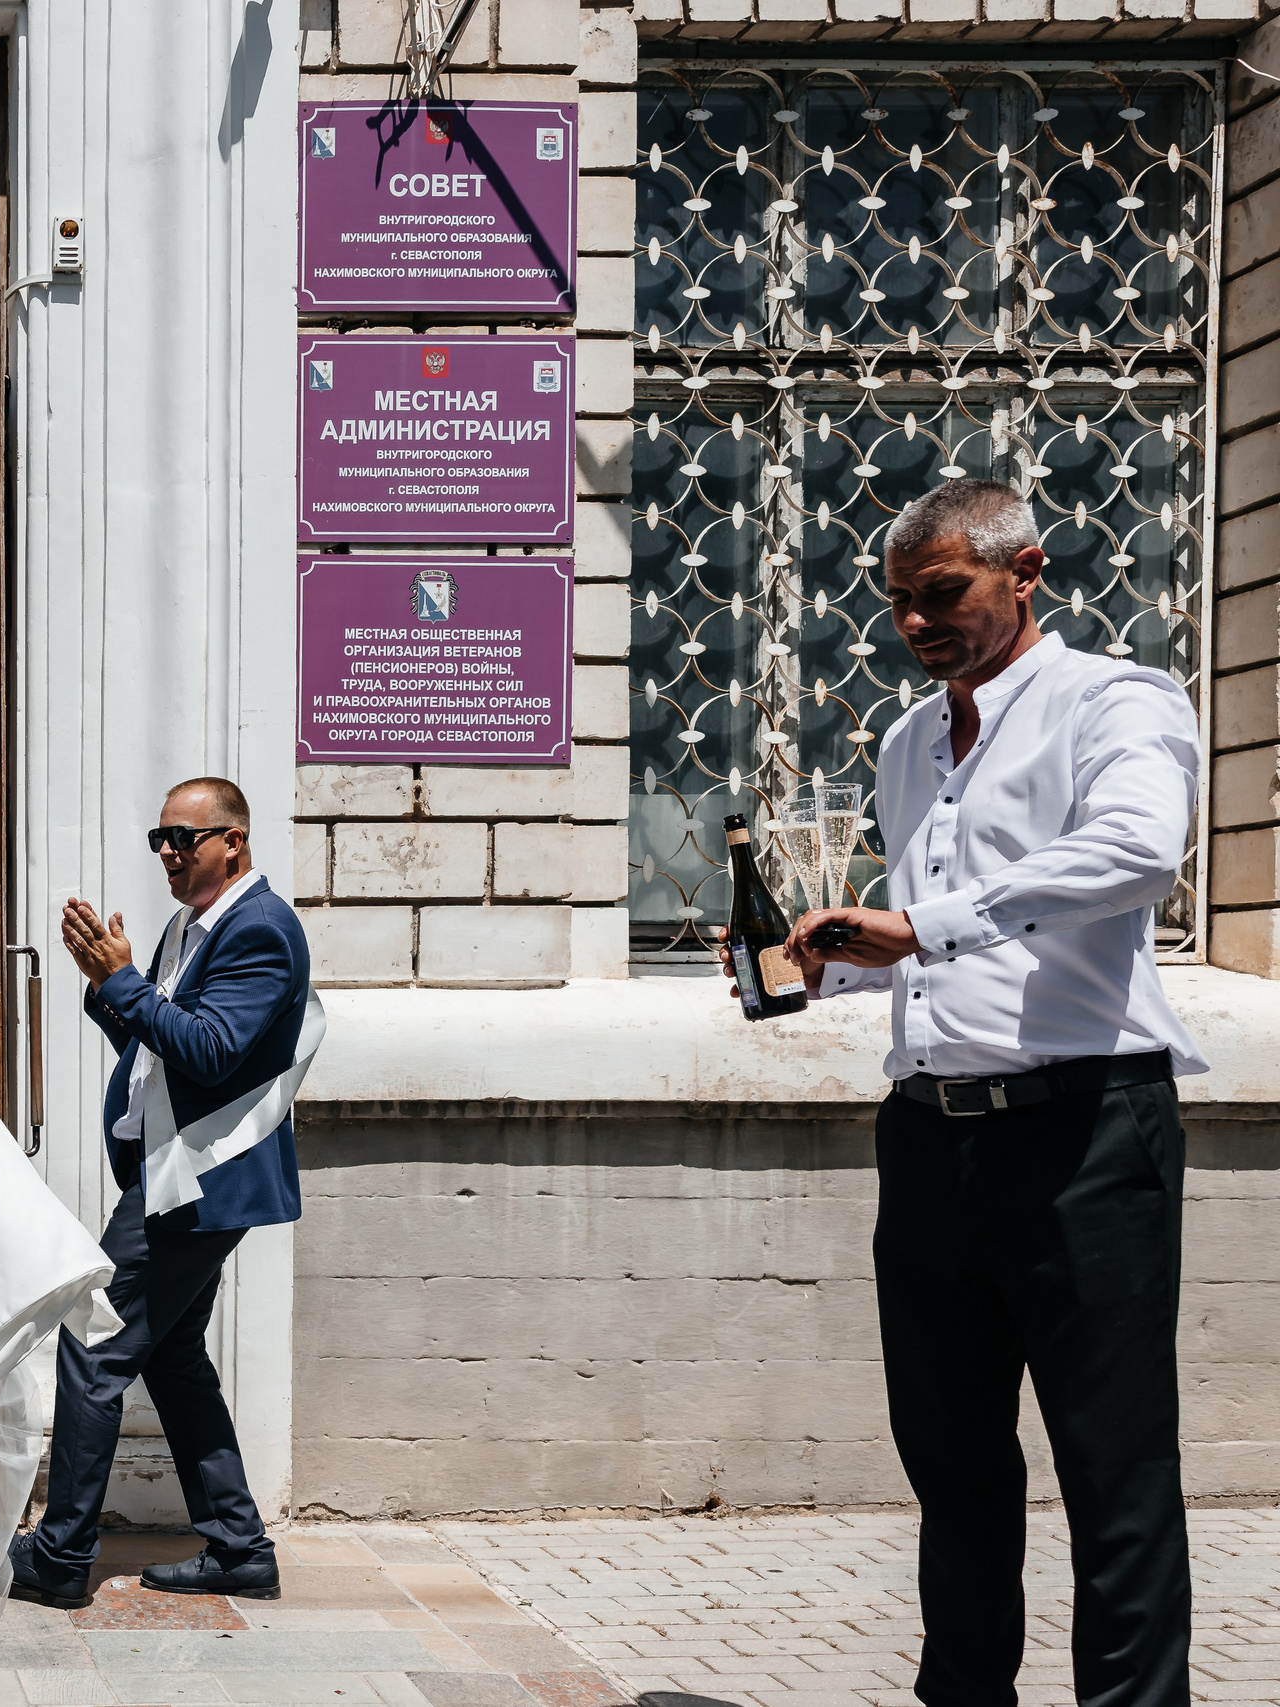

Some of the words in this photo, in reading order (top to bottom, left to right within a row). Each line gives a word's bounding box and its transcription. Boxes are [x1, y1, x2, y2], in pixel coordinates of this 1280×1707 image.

[389, 174, 487, 197] СОВЕТ
[379, 215, 496, 226] ВНУТРИГОРОДСКОГО
[341, 232, 448, 244] МУНИЦИПАЛЬНОГО
[450, 233, 532, 243] ОБРАЗОВАНИЯ
[391, 252, 398, 260] г.
[400, 250, 482, 260] СЕВАСТОПОЛЯ
[314, 267, 406, 278] НАХИМОВСКОГО
[407, 268, 515, 279] МУНИЦИПАЛЬНОГО
[516, 268, 558, 279] ОКРУГА
[374, 390, 497, 411] МЕСТНАЯ
[320, 419, 551, 444] АДМИНИСТРАЦИЯ
[376, 450, 493, 461] ВНУТРИГОРОДСКОГО
[338, 467, 445, 479] МУНИЦИПАЛЬНОГО
[447, 467, 530, 478] ОБРАЗОВАНИЯ
[388, 487, 395, 495] г.
[398, 485, 480, 495] СЕВАСТОПОЛЯ
[312, 502, 403, 512] НАХИМОВСКОГО
[405, 502, 512, 514] МУНИЦИПАЛЬНОГО
[514, 503, 556, 513] ОКРУГА
[344, 628, 407, 640] МЕСТНАЯ
[410, 629, 522, 642] ОБЩЕСТВЕННАЯ
[343, 645, 440, 658] ОРГАНИЗАЦИЯ
[443, 646, 522, 657] ВЕТЕРАНОВ
[350, 662, 458, 676] (ПЕНСИОНЕРОВ)
[462, 661, 515, 677] ВОЙНЫ,
[341, 679, 386, 692] ТРУДА,
[389, 679, 492, 691] ВООРУЖЕННЫХ
[496, 680, 523, 692] СИЛ
[313, 696, 322, 706] И
[326, 696, 486, 708] ПРАВООХРАНИТЕЛЬНЫХ
[489, 697, 551, 709] ОРГАНОВ
[313, 712, 420, 724] НАХИМОВСКОГО
[424, 713, 551, 727] МУНИЦИПАЛЬНОГО
[328, 729, 378, 741] ОКРУГА
[381, 730, 434, 743] ГОРОДА
[437, 730, 535, 742] СЕВАСТОПОЛЯ
